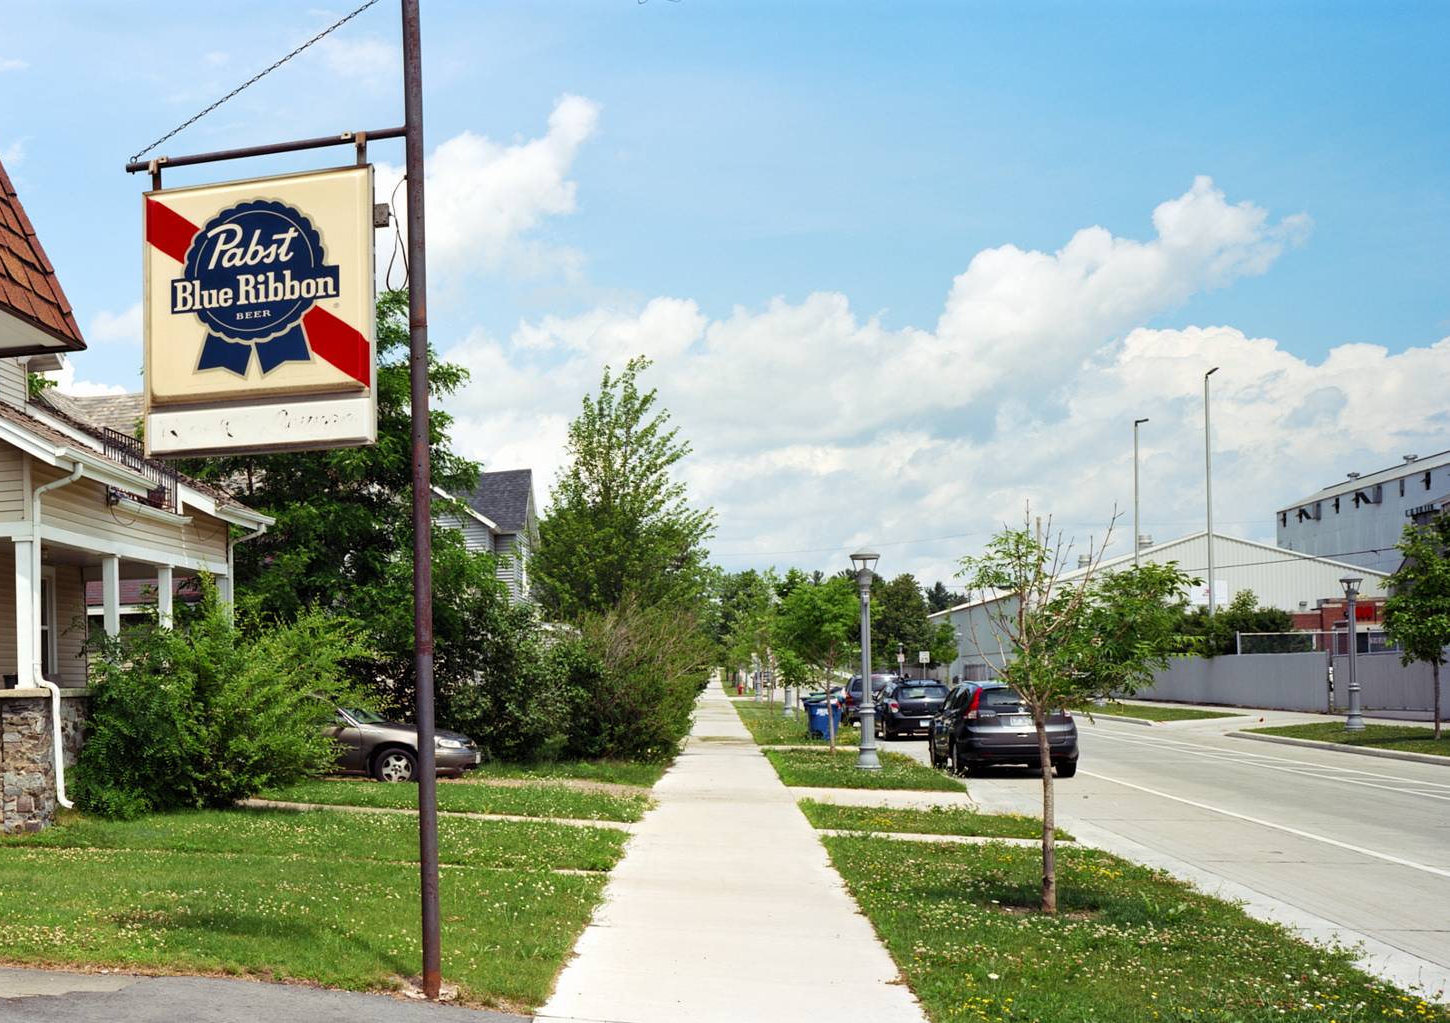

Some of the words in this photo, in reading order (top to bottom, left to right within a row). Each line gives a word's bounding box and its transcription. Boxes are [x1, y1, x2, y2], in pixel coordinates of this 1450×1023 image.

[207, 223, 298, 270] Pabst
[173, 279, 234, 312] Blue
[236, 270, 337, 305] Ribbon
[236, 309, 271, 320] BEER
